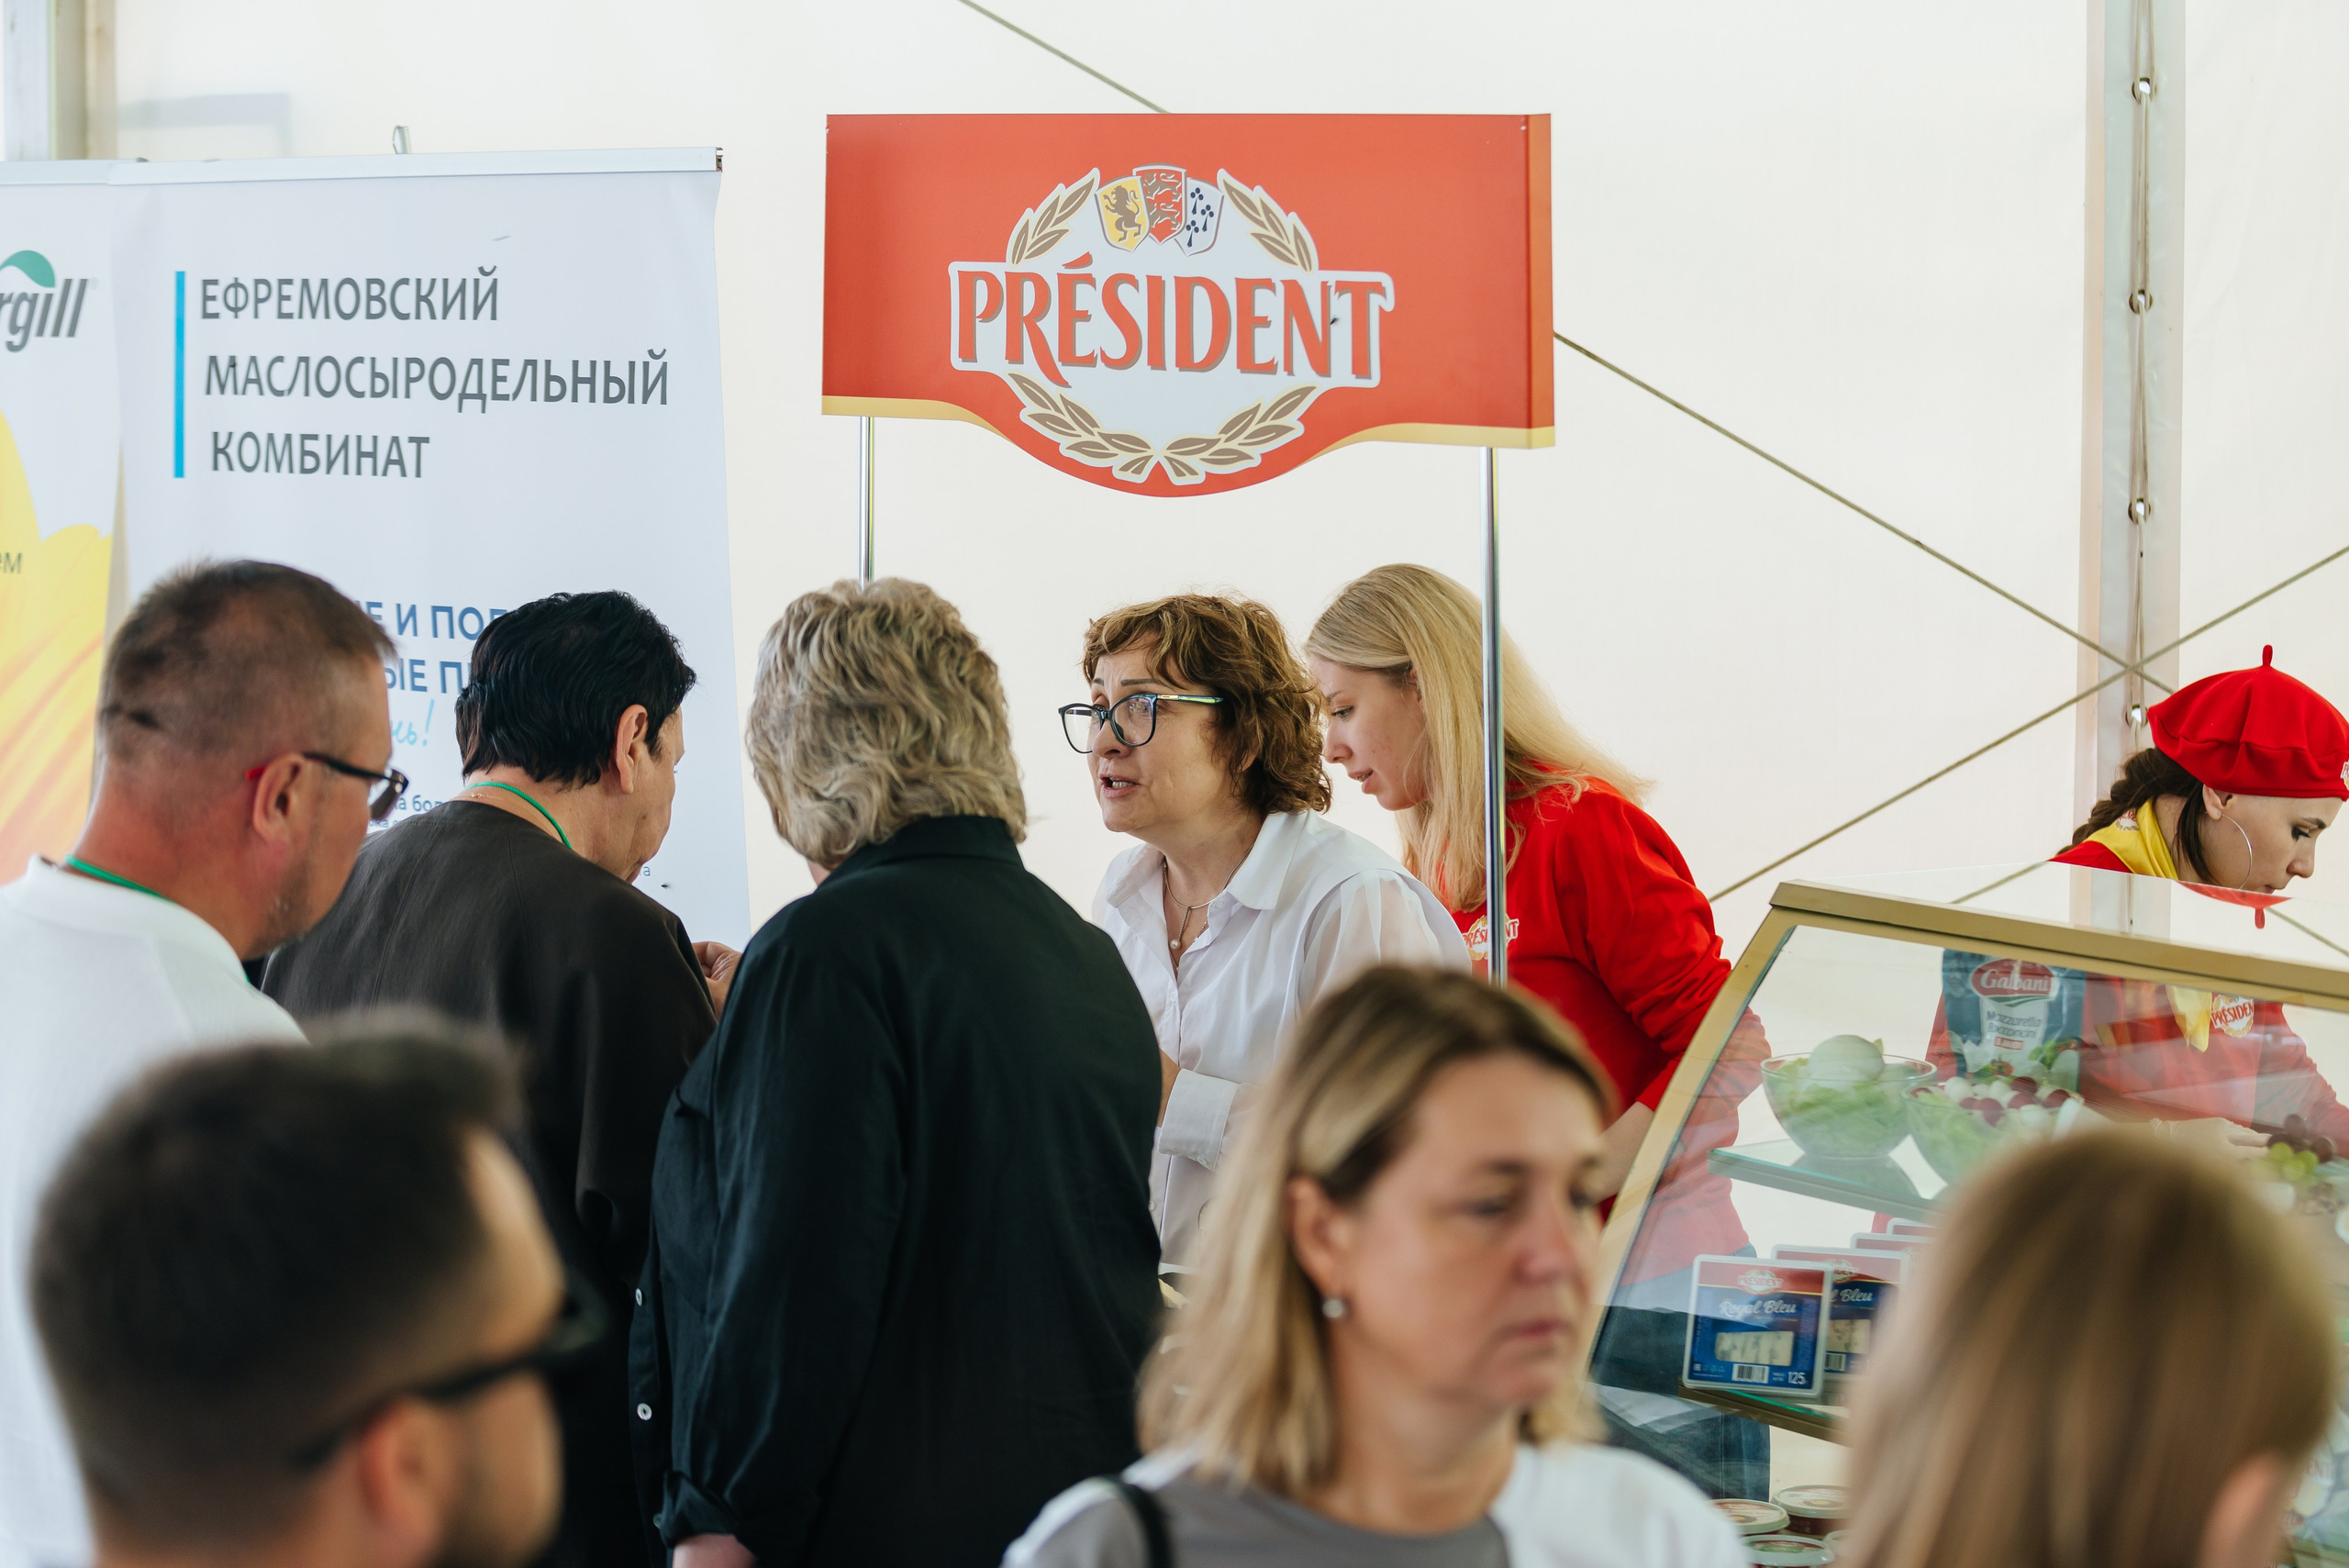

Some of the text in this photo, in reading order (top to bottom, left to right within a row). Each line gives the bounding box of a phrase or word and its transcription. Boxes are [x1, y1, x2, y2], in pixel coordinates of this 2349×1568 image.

[200, 264, 499, 321] ЕФРЕМОВСКИЙ
[957, 250, 1387, 388] PRÉSIDENT
[204, 348, 669, 414] МАСЛОСЫРОДЕЛЬНЫЙ
[210, 430, 430, 478] КОМБИНАТ
[395, 603, 418, 638] И
[430, 606, 508, 640] ПО
[1763, 1299, 1798, 1314] Bleu
